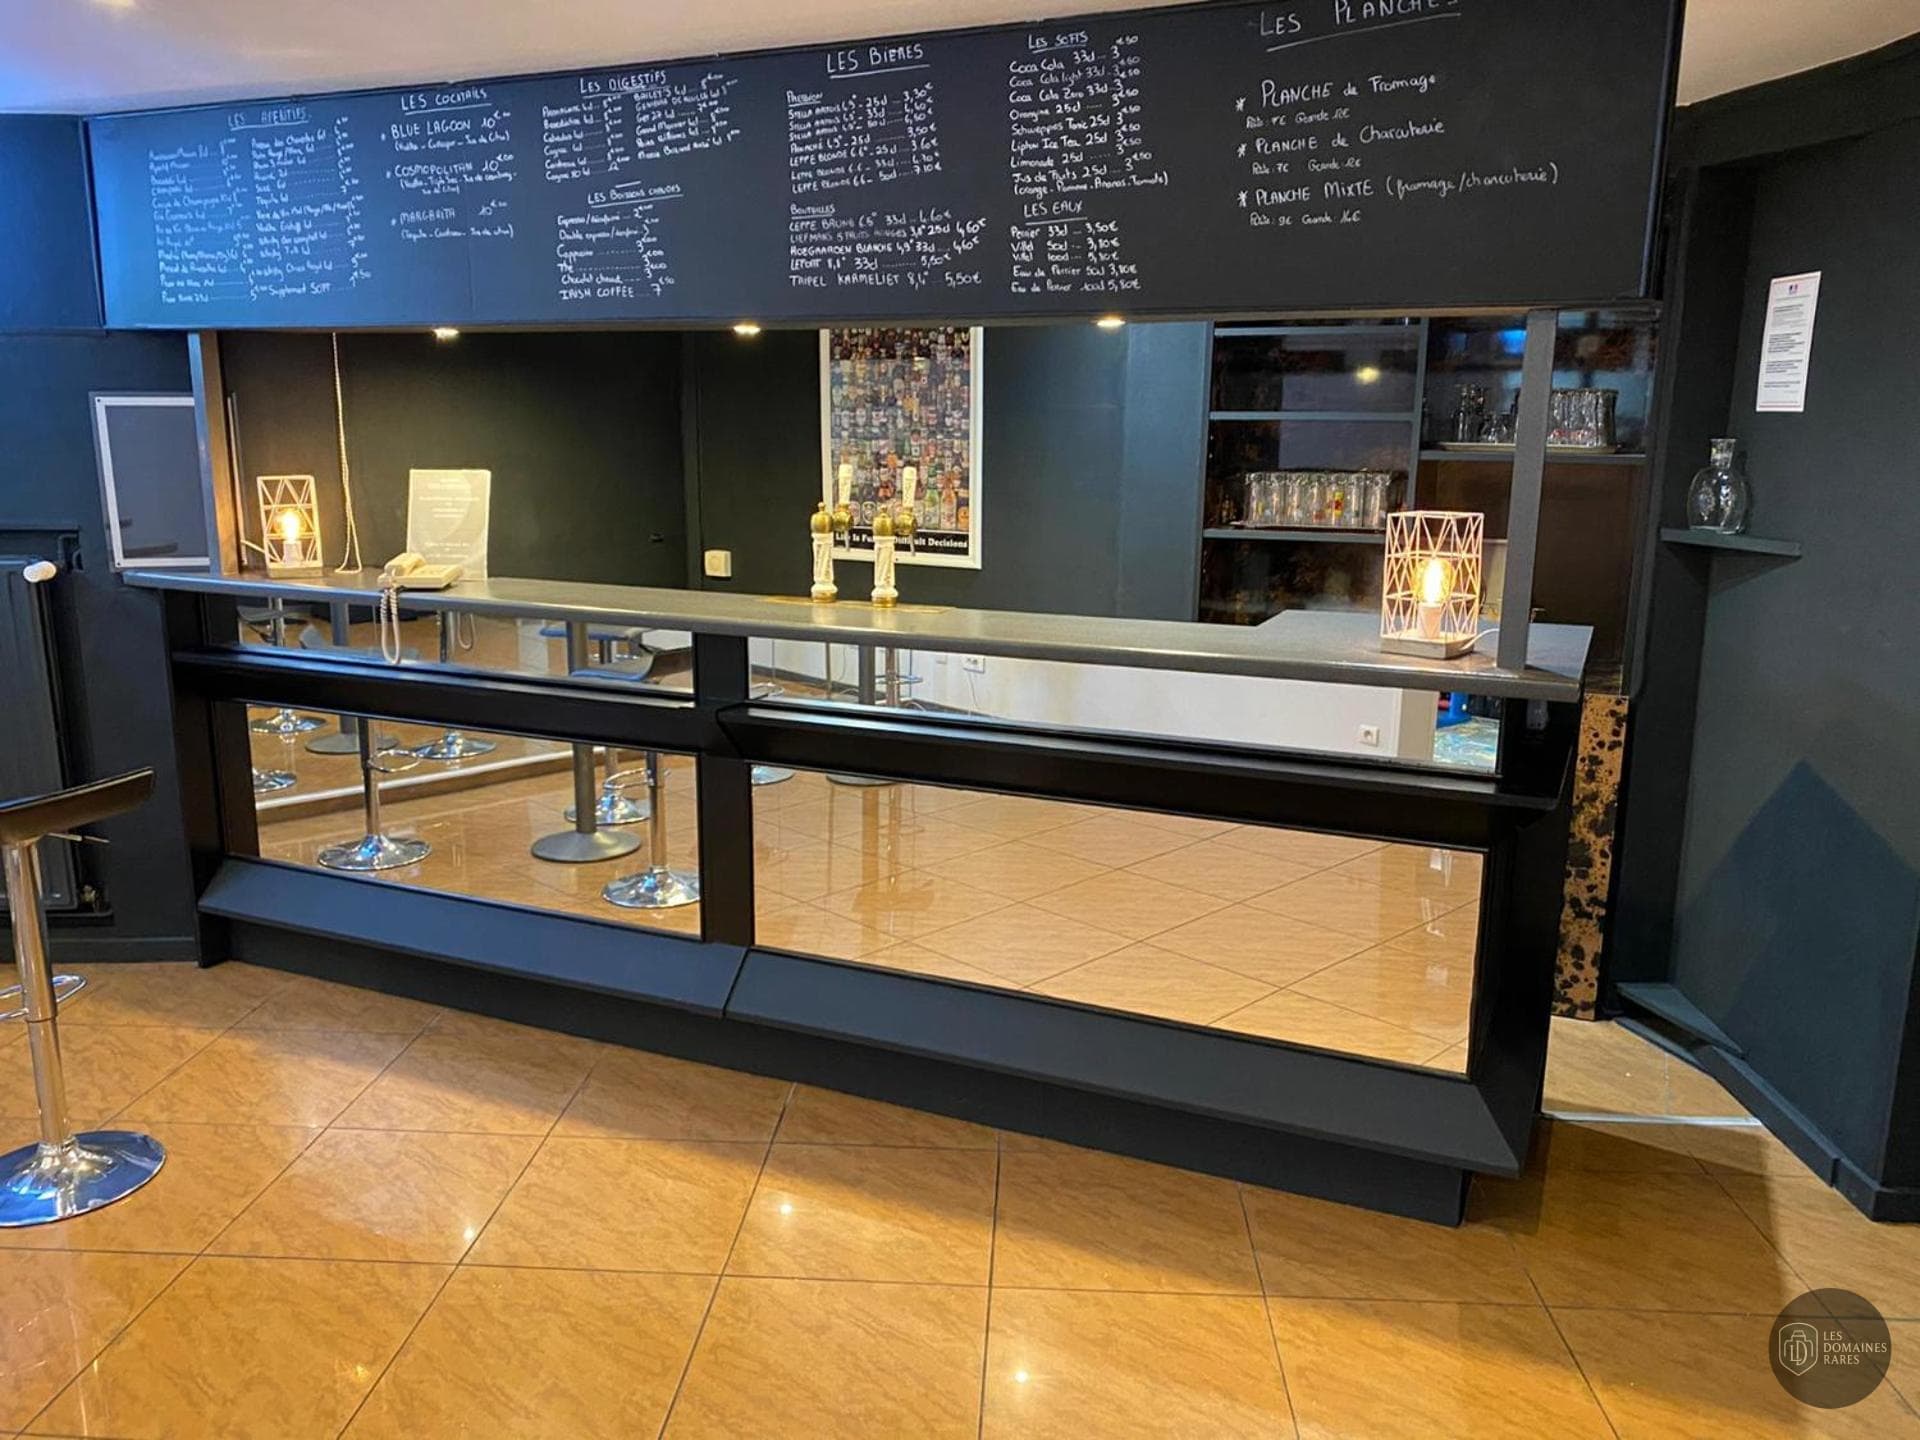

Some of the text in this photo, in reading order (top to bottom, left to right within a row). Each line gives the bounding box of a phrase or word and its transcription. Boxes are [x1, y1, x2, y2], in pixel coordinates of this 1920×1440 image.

[1260, 11, 1302, 37] LES
[826, 50, 859, 73] LES
[1009, 60, 1039, 74] Coca
[1040, 58, 1065, 71] Cola
[1009, 76, 1034, 88] Coca
[1009, 91, 1033, 103] Coca
[1039, 88, 1060, 101] Cola
[1260, 73, 1436, 108] PLANCHE de Fromage
[401, 94, 427, 111] LES
[391, 119, 471, 139] BLUE LAGOON
[1255, 116, 1446, 155] PLANCHE de Charcuterie
[395, 161, 472, 177] COSMOPOLITAN
[588, 191, 606, 204] LES
[1255, 186, 1311, 207] PLANCHE
[1024, 199, 1083, 218] LES EAUX
[789, 274, 828, 287] TRIPEL
[837, 272, 900, 286] KARMELIET
[597, 286, 635, 298] COFFEE
[927, 538, 968, 549] Decisions
